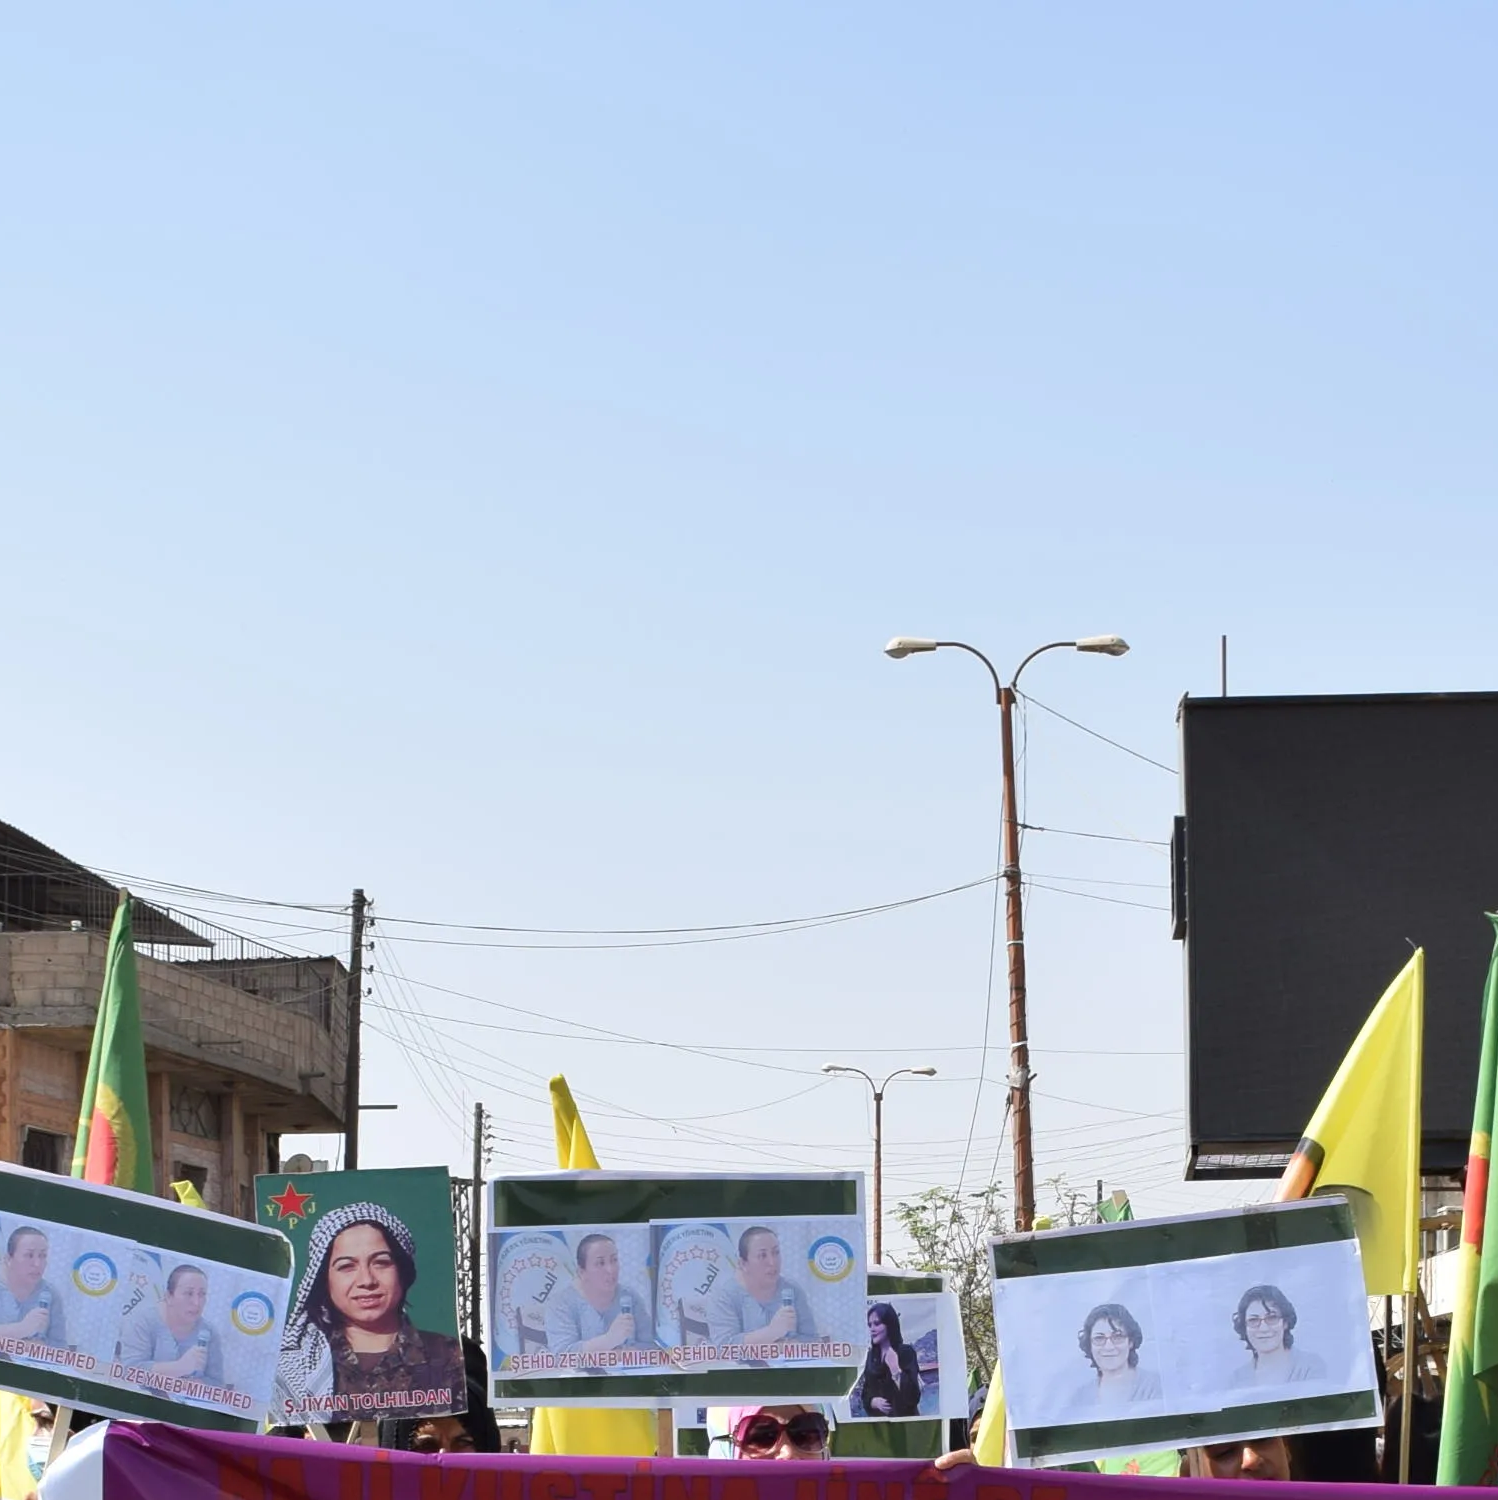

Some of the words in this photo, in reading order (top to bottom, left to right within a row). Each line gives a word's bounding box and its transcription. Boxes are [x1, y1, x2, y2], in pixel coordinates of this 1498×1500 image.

[721, 1344, 779, 1360] ZEYNEB
[785, 1343, 852, 1359] MIHEMED
[352, 1388, 452, 1407] TOLHILDAN
